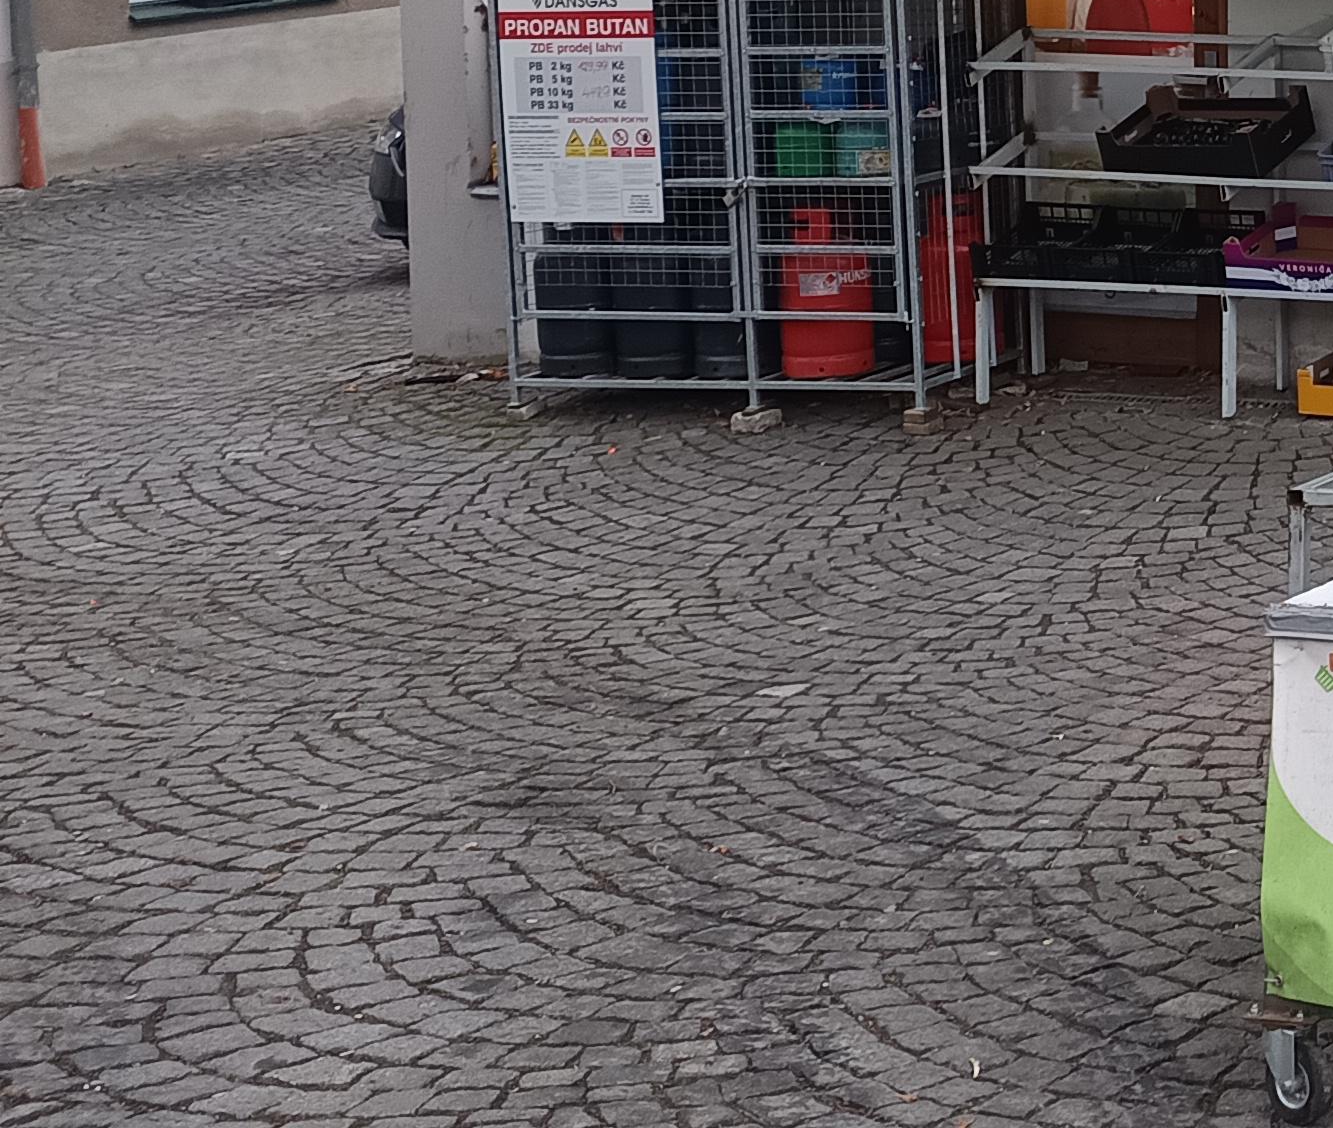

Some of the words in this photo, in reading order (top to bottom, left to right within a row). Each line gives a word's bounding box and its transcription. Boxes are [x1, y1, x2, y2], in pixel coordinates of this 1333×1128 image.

[504, 19, 580, 36] PROPAN
[586, 18, 648, 35] BUTAN
[530, 43, 553, 53] ZDE
[557, 42, 592, 55] prodej
[595, 41, 623, 53] lahví
[529, 62, 543, 71] PB
[550, 62, 558, 71] 2
[560, 61, 572, 72] kg
[612, 61, 625, 70] Kč
[530, 75, 543, 83] PB
[551, 75, 558, 83] 5
[560, 74, 573, 85] kg
[613, 74, 626, 83] Kč
[530, 88, 544, 96] PB
[547, 88, 559, 96] 10
[561, 87, 573, 98] kg
[613, 87, 627, 96] Kč
[531, 101, 545, 109] PB
[547, 101, 559, 109] 33
[562, 100, 574, 111] kg
[614, 100, 627, 109] Kč
